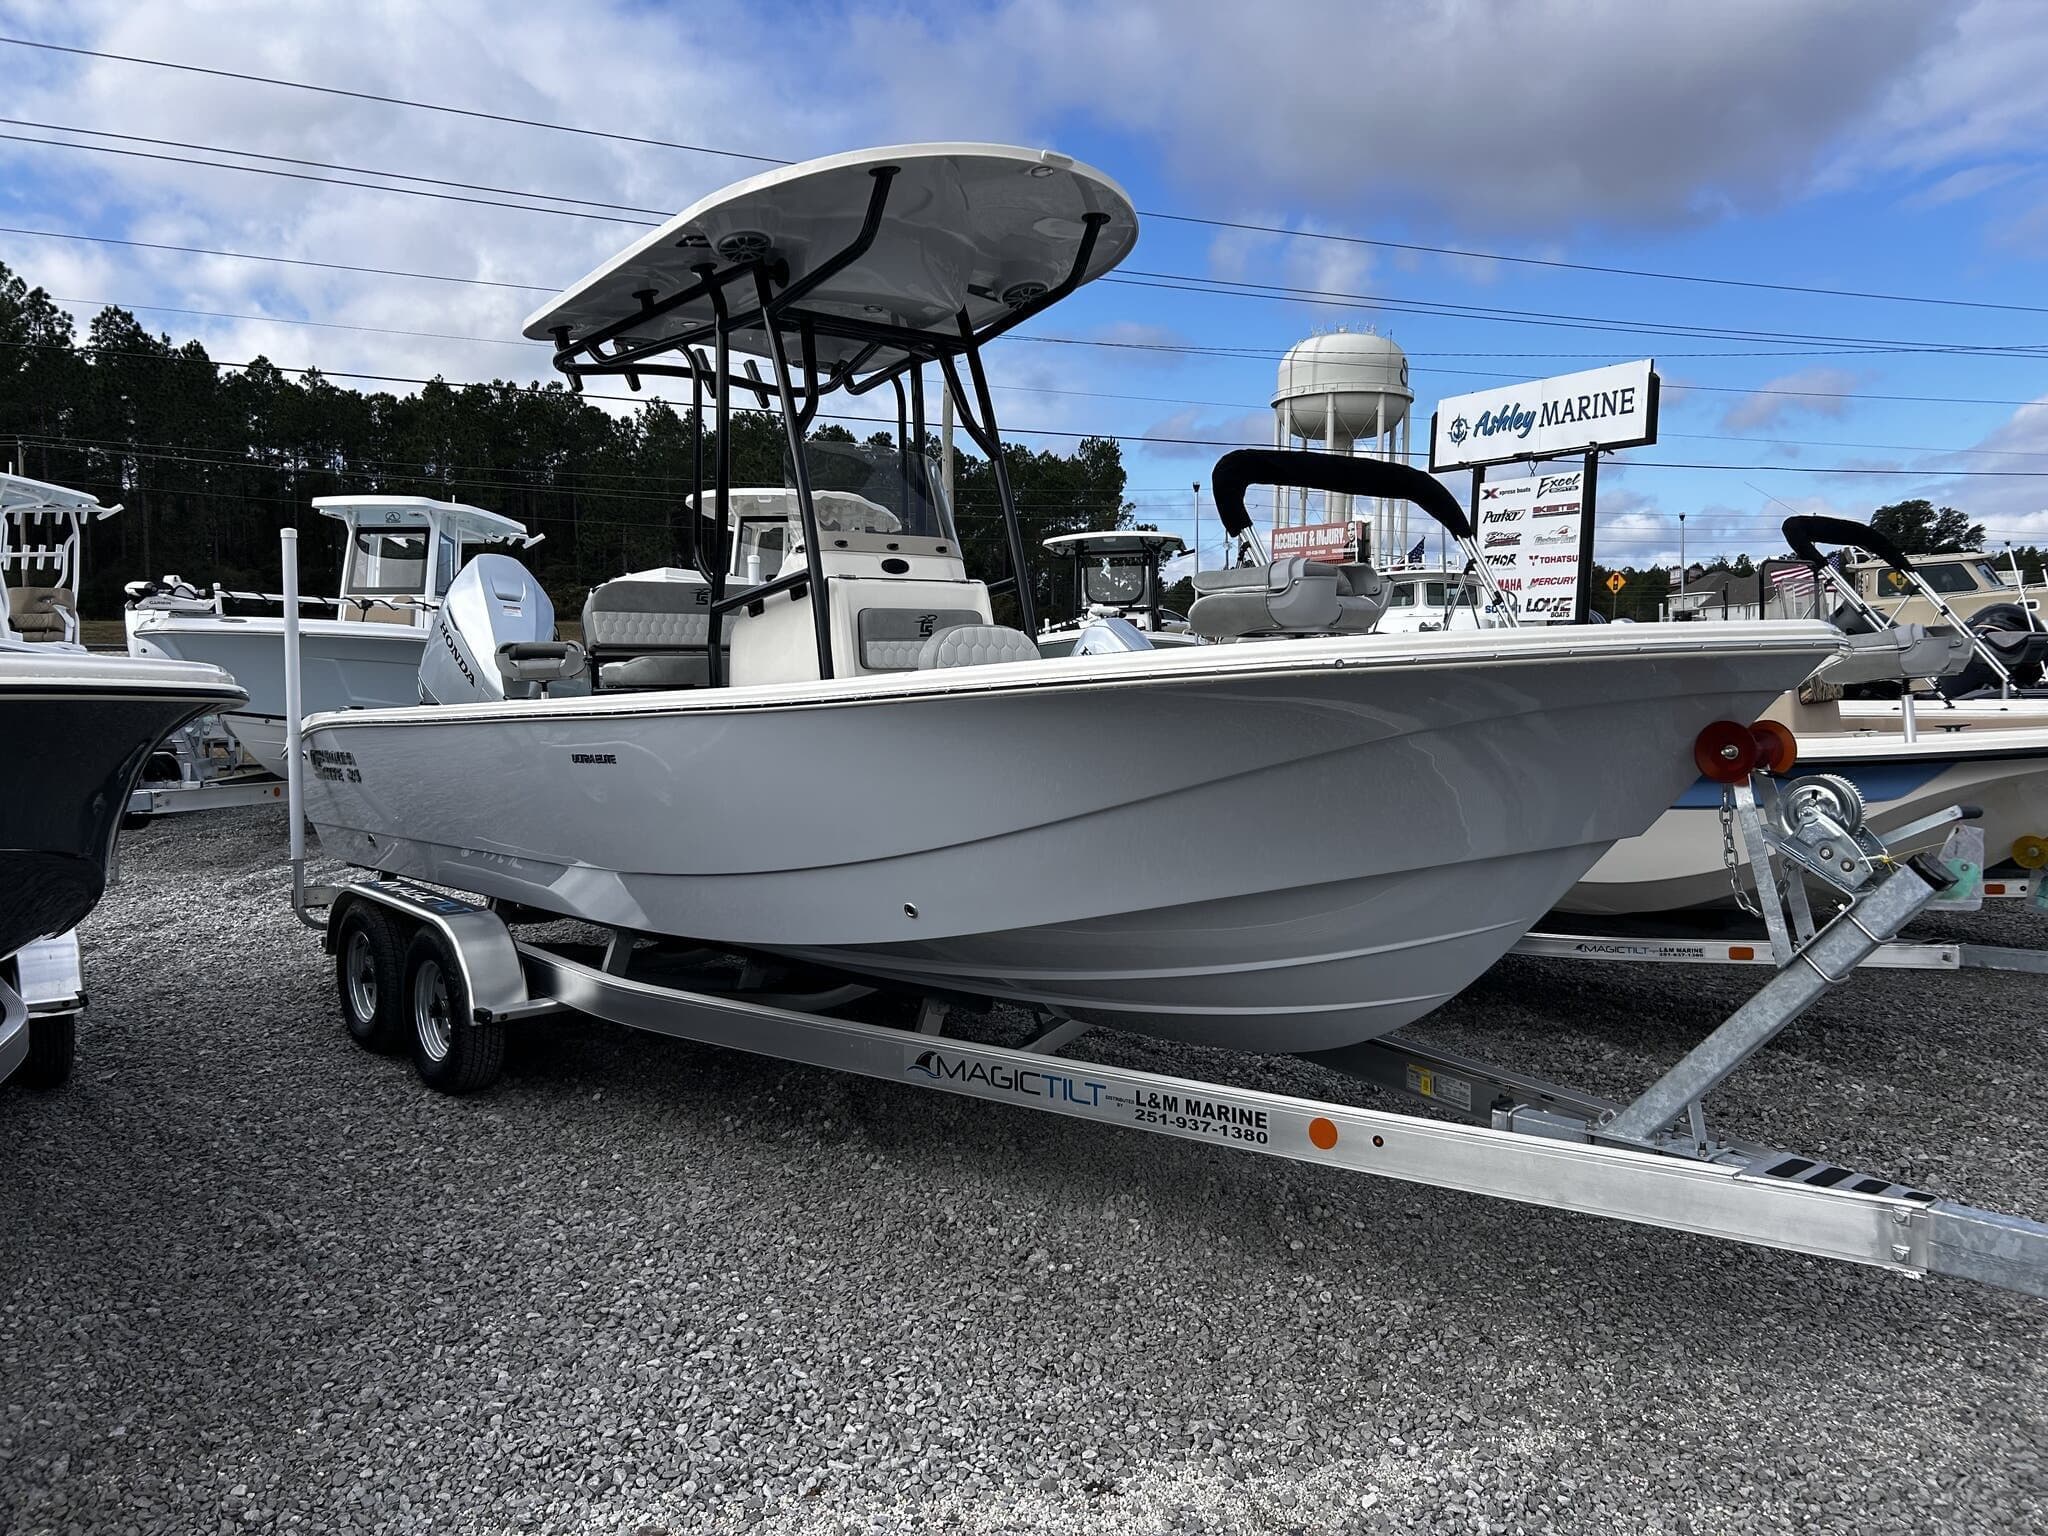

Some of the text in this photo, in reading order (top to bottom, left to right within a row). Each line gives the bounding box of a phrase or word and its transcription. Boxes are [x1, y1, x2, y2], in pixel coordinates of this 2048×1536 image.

[1473, 387, 1635, 439] Ashley MARINE
[1536, 473, 1581, 499] Excel
[1482, 508, 1522, 524] Parker
[1274, 527, 1346, 550] ACCIDENT & INJURY.
[1485, 553, 1517, 566] THOR
[1540, 554, 1578, 564] TOHATSU
[1498, 578, 1522, 591] MAHA
[1530, 576, 1577, 586] MERCURY
[1526, 597, 1573, 613] LOWE
[440, 620, 475, 688] HONDA
[936, 1055, 1107, 1107] MAGICTILT
[1135, 1089, 1268, 1130] L&M MARINE
[1134, 1108, 1269, 1144] 251-937-1380
